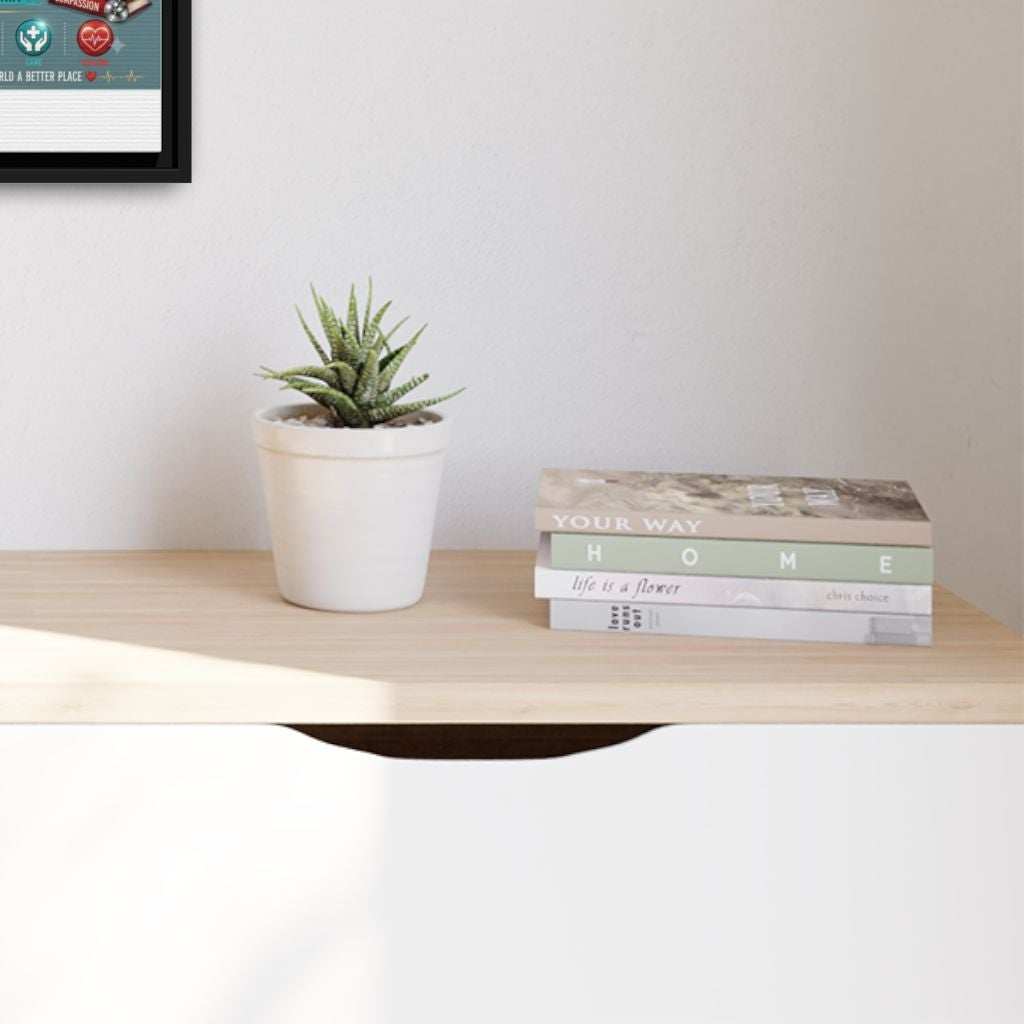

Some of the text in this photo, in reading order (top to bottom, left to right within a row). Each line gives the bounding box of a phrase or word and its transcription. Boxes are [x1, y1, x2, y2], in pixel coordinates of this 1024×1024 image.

[16, 70, 23, 82] A
[26, 70, 55, 82] BETTER
[58, 70, 82, 82] PLACE
[552, 514, 703, 534] YOUR WAY
[587, 544, 893, 574] HOME
[572, 575, 682, 599] life is a flower
[826, 589, 889, 603] chris choice
[608, 606, 620, 629] love
[622, 606, 630, 630] runs
[632, 609, 642, 628] out
